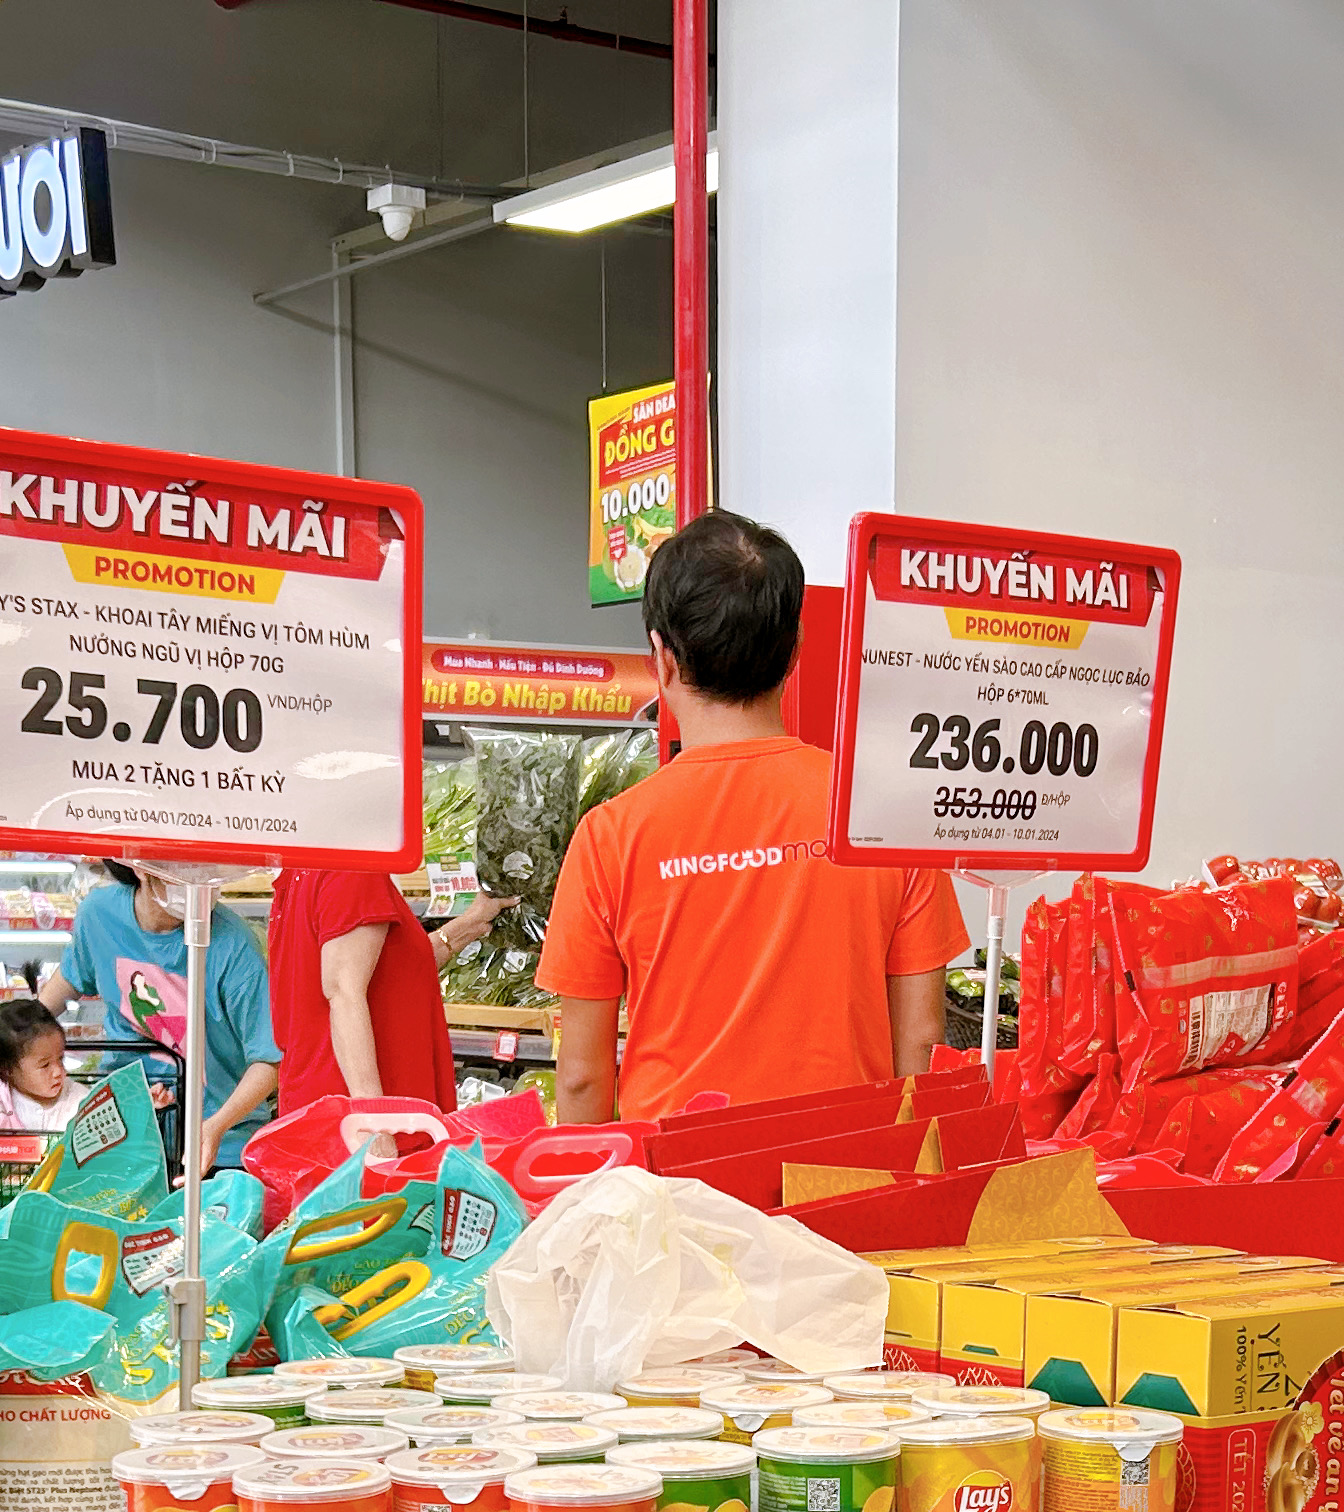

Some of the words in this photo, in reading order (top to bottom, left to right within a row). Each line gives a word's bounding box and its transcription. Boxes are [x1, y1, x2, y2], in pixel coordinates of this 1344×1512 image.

[656, 394, 676, 415] DEA
[605, 424, 656, 467] ĐỒNG
[602, 474, 670, 523] 10.000
[248, 501, 347, 558] MÃI
[95, 556, 255, 595] PROMOTION
[900, 549, 1054, 601] KHUYẾN
[1066, 562, 1128, 608] MÃI
[31, 599, 79, 619] STAX
[96, 606, 153, 628] KHOAI
[158, 607, 190, 632] TÂY
[196, 611, 255, 639] MIẾNG
[261, 623, 278, 645] VỊ
[284, 623, 324, 645] TÔM
[329, 627, 370, 650] HÙM
[965, 616, 1070, 642] PROMOTION
[70, 634, 137, 659] NƯỚNG
[142, 638, 180, 663] NGŨ
[187, 649, 202, 671] VỊ
[207, 646, 245, 673] HỘP
[249, 654, 284, 674] 70G
[924, 652, 961, 671] NƯỚC
[965, 652, 990, 673] YẾN
[994, 658, 1016, 675] SÀO
[1020, 662, 1041, 677] CAO
[1045, 660, 1066, 680] CẤP
[1070, 666, 1099, 684] NGỌC
[1102, 670, 1123, 686] LỤC
[1126, 667, 1150, 686] BẢO
[21, 666, 263, 752] 25.700
[422, 679, 457, 709] hịt
[463, 678, 496, 706] Bò
[502, 683, 566, 715] Nhập
[572, 683, 631, 713] Khẩu
[977, 683, 1004, 704] HỘP
[910, 712, 1099, 777] 236.000
[73, 760, 119, 782] MUA
[125, 763, 135, 782] 2
[141, 761, 196, 789] TẶNG
[201, 770, 208, 789] 1
[217, 763, 256, 792] BẤT
[261, 770, 285, 794] KỲ
[1236, 1436, 1249, 1481] TẾT
